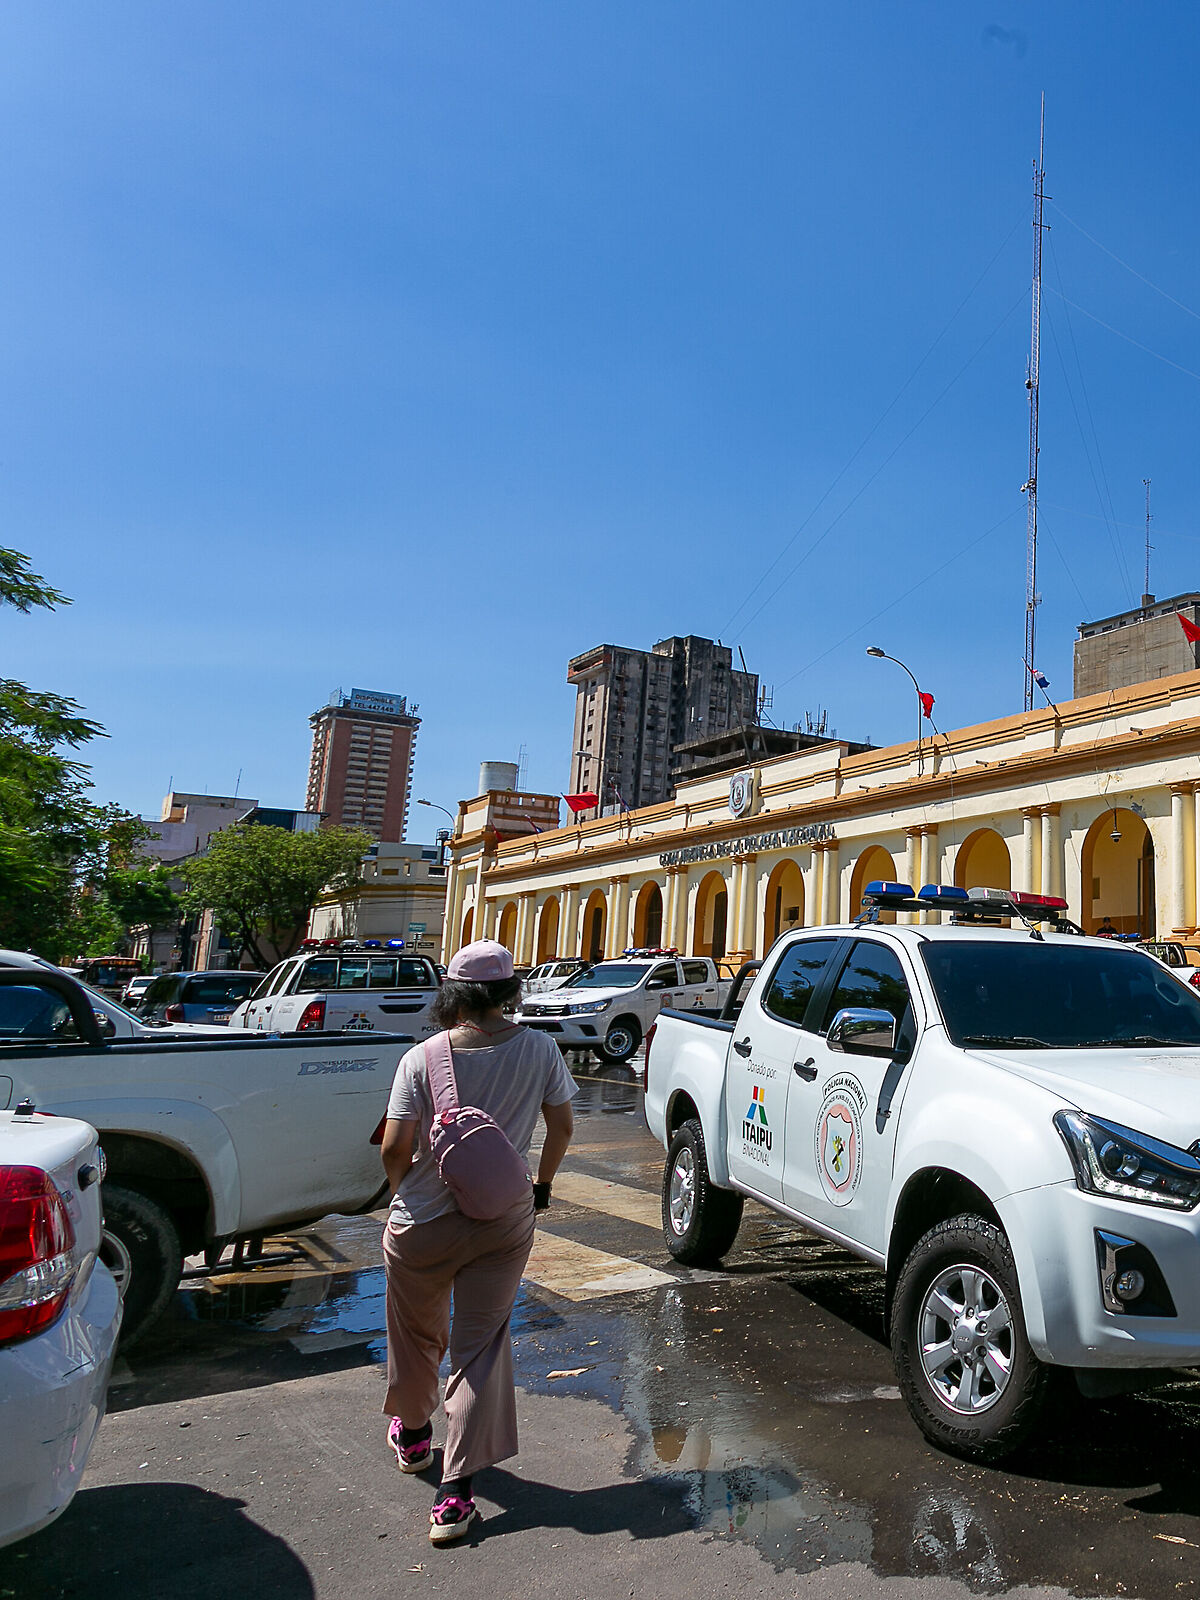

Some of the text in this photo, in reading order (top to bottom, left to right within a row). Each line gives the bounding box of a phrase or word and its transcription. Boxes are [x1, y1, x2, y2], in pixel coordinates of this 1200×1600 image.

[341, 1023, 375, 1031] ITAIPU
[747, 1059, 766, 1076] Donado
[824, 1077, 865, 1110] POLICIA NACIONAL
[742, 1120, 773, 1151] ITAIPU
[742, 1143, 770, 1167] BINACIONAL
